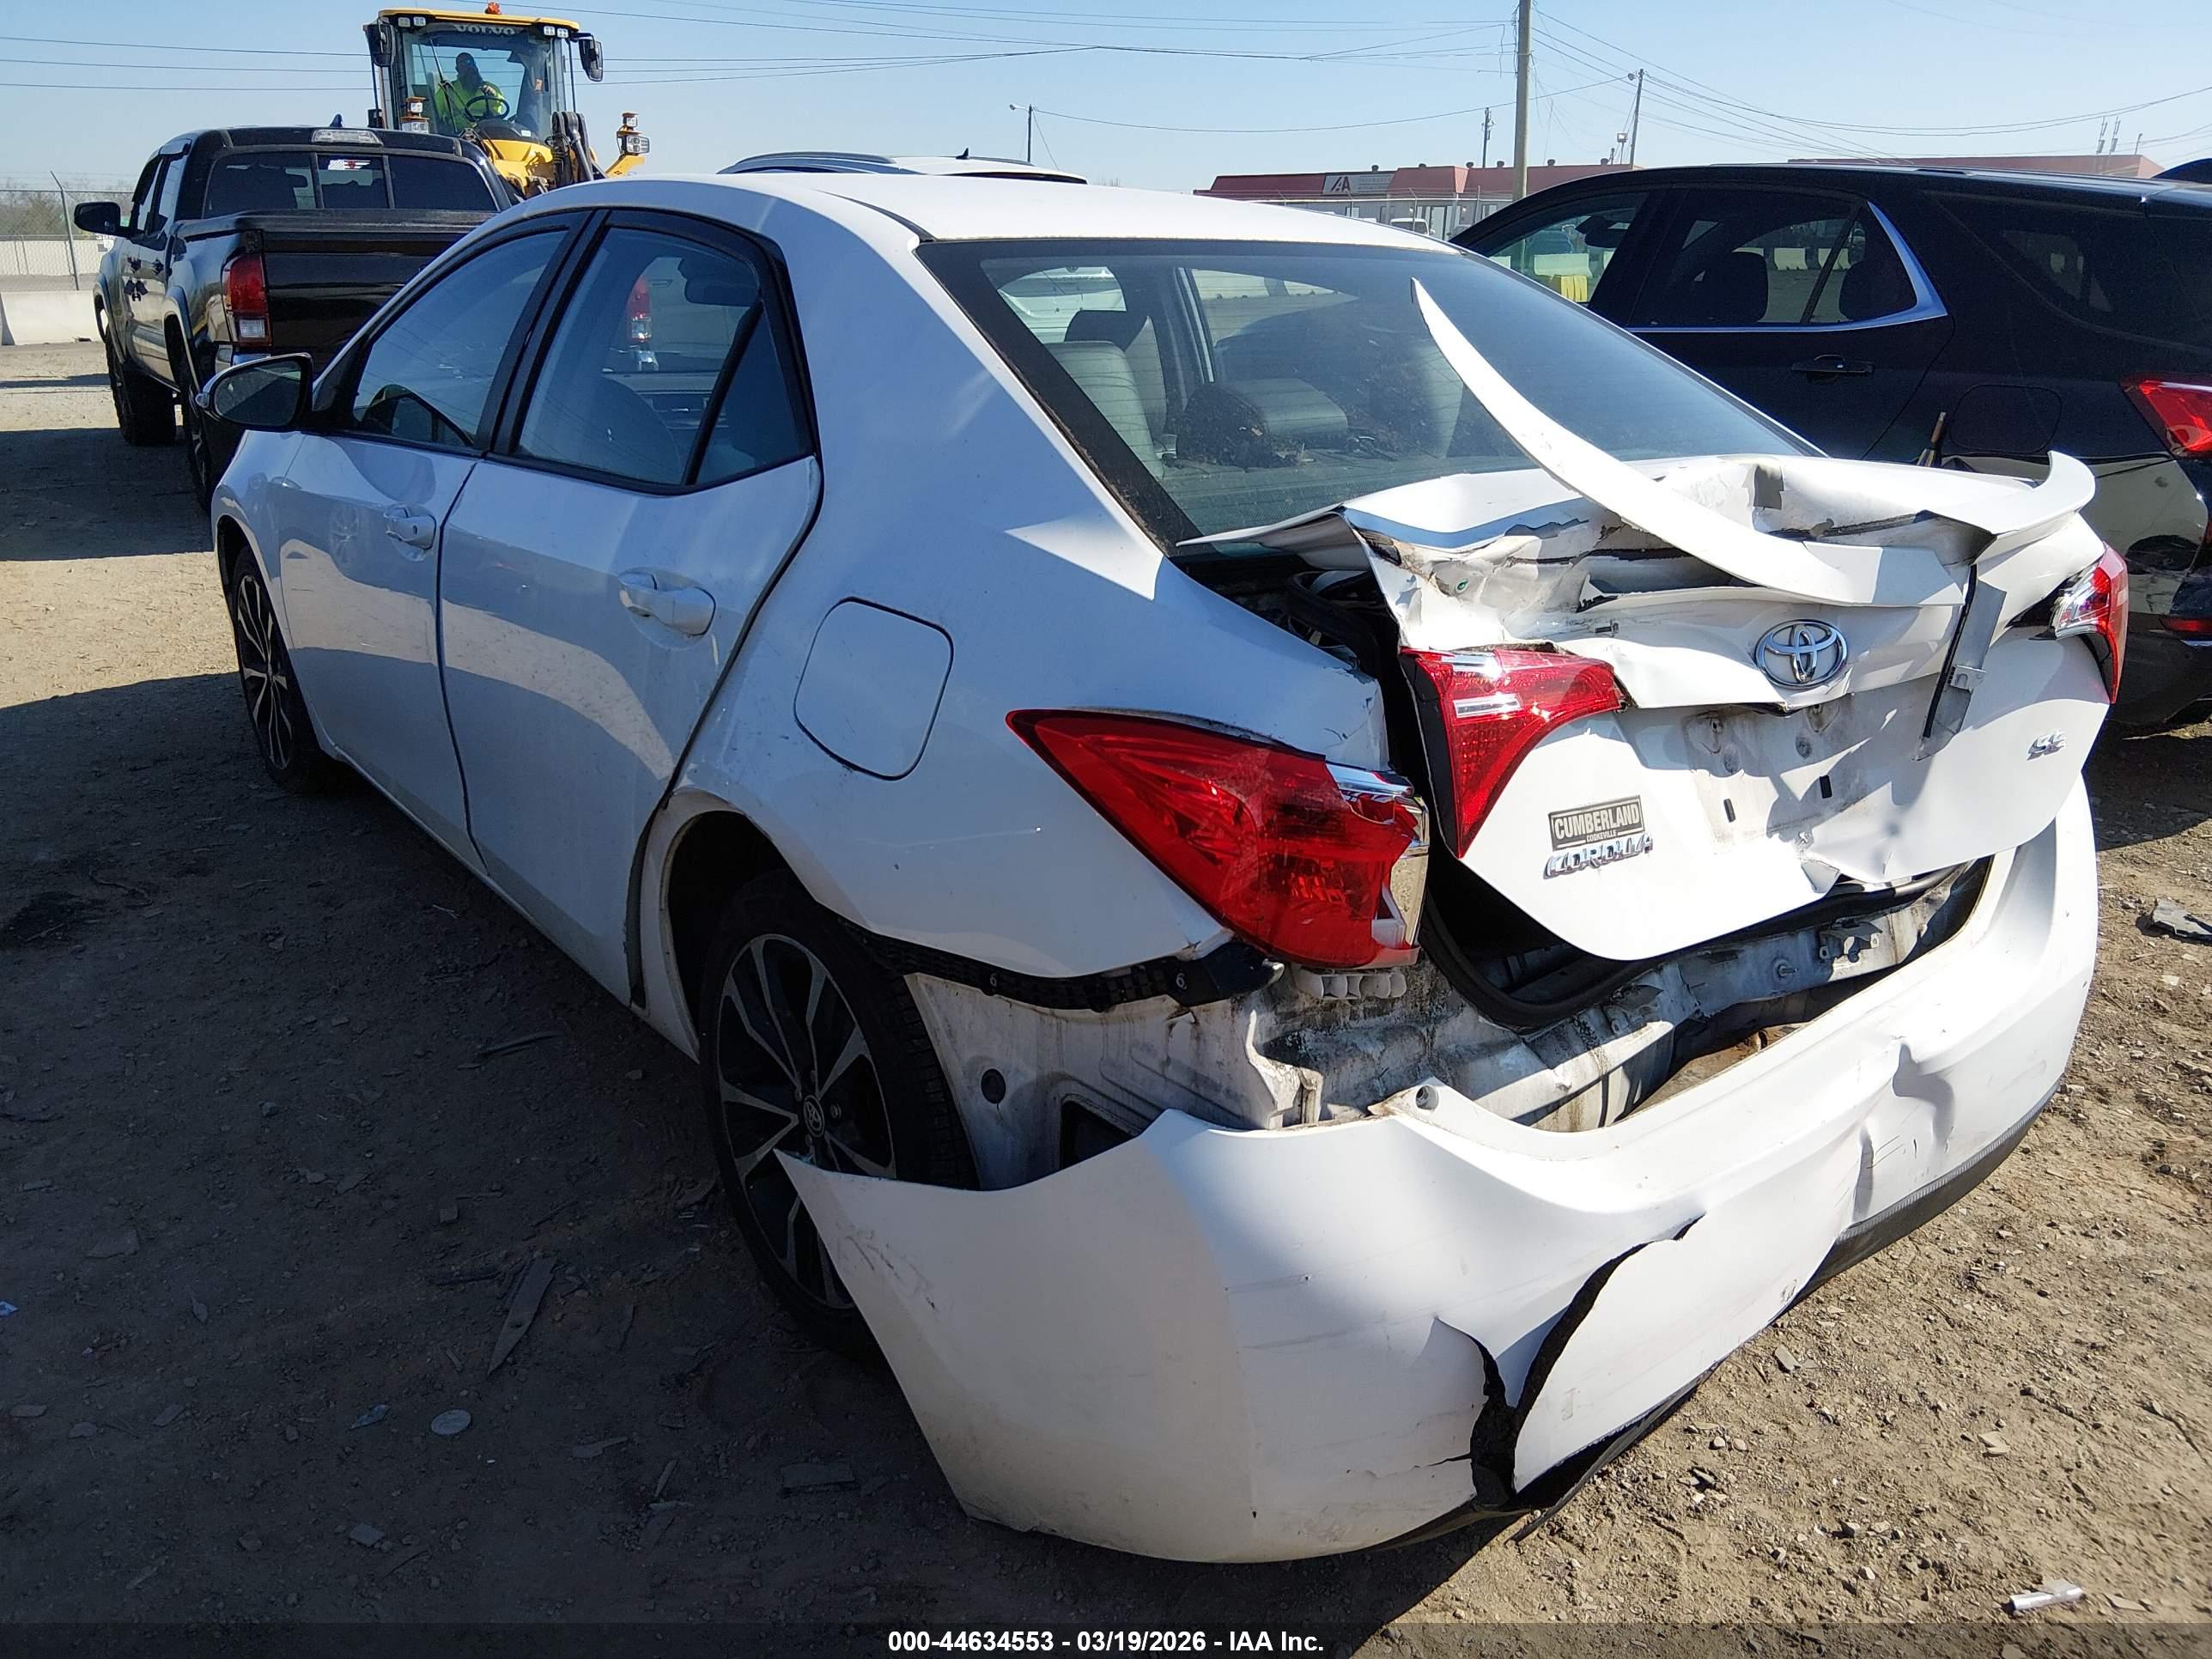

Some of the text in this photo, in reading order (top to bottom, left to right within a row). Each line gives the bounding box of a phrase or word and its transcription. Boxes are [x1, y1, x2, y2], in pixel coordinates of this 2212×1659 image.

[453, 24, 515, 35] VOLVO
[1554, 803, 1639, 840] CUMBERLAND
[1586, 830, 1617, 842] COOKEVILLE
[1544, 833, 1653, 879] COROLLA
